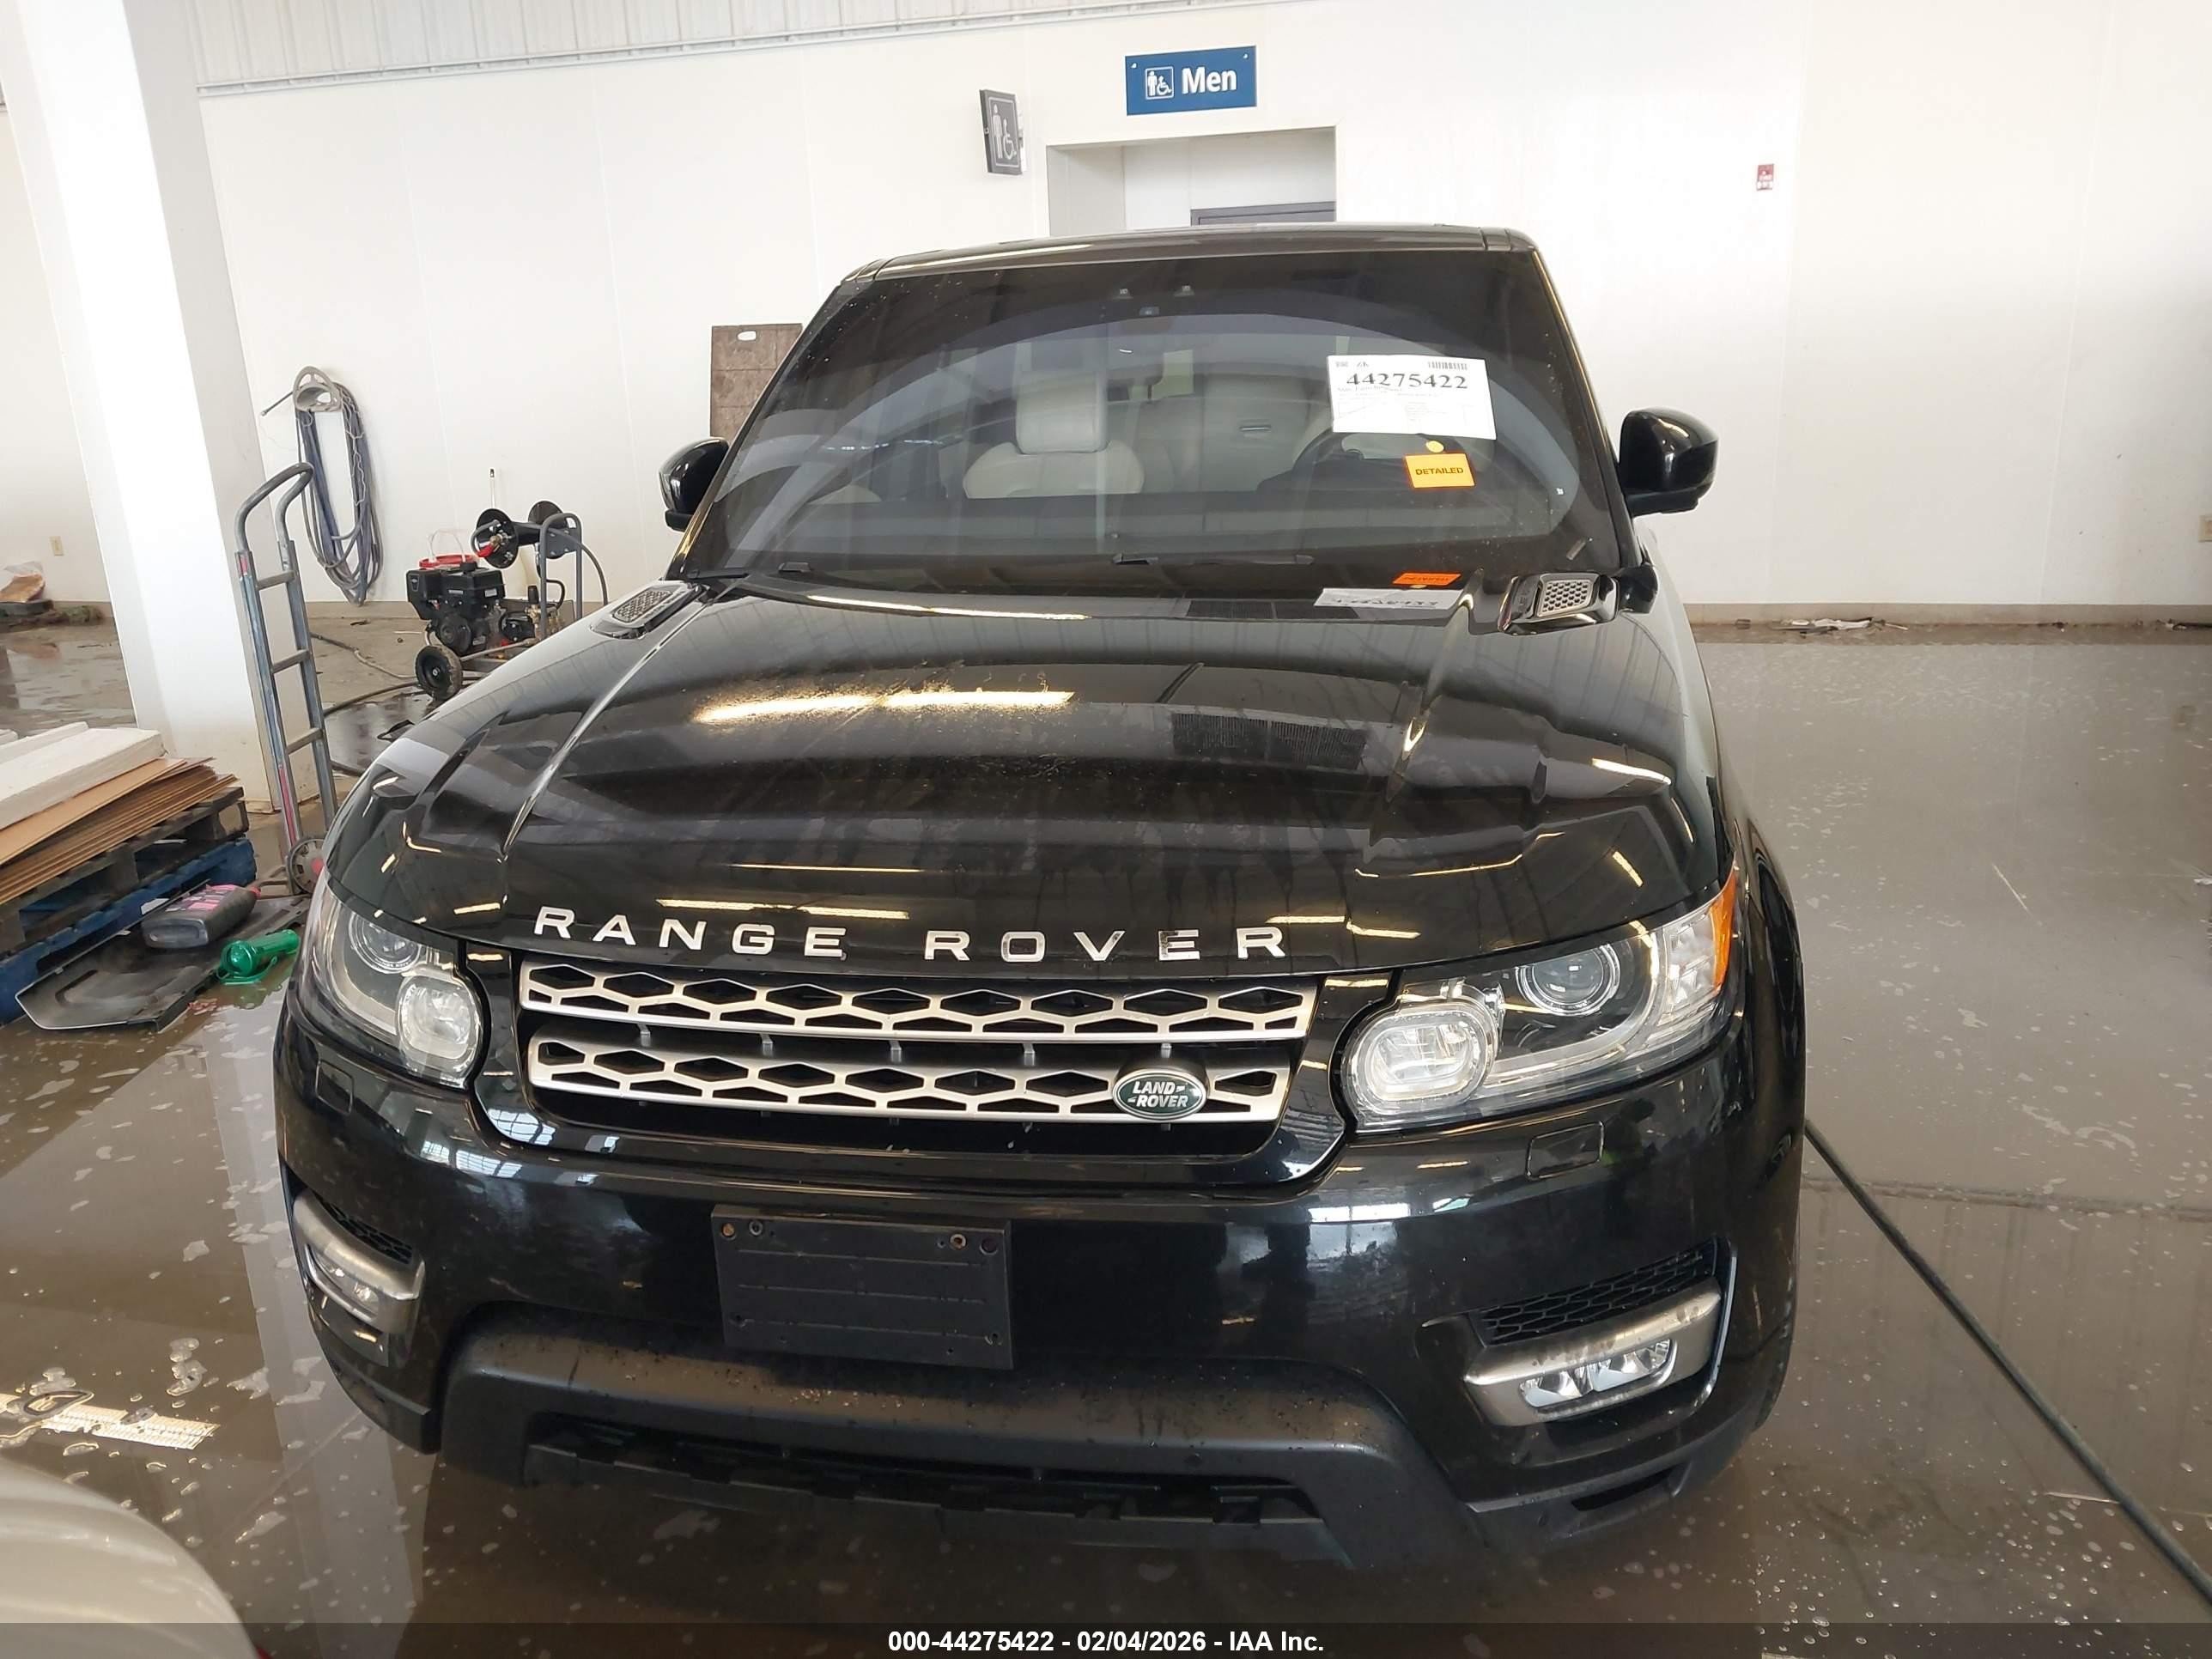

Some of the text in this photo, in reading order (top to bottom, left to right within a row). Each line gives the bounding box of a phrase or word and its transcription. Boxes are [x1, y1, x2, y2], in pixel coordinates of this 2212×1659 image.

[1182, 66, 1237, 94] Men
[1346, 373, 1468, 389] 44275422
[1414, 467, 1464, 476] DETAILED
[533, 906, 1286, 962] RANGE ROVER
[1132, 1080, 1176, 1095] LAND
[1135, 1094, 1189, 1108] ROVER
